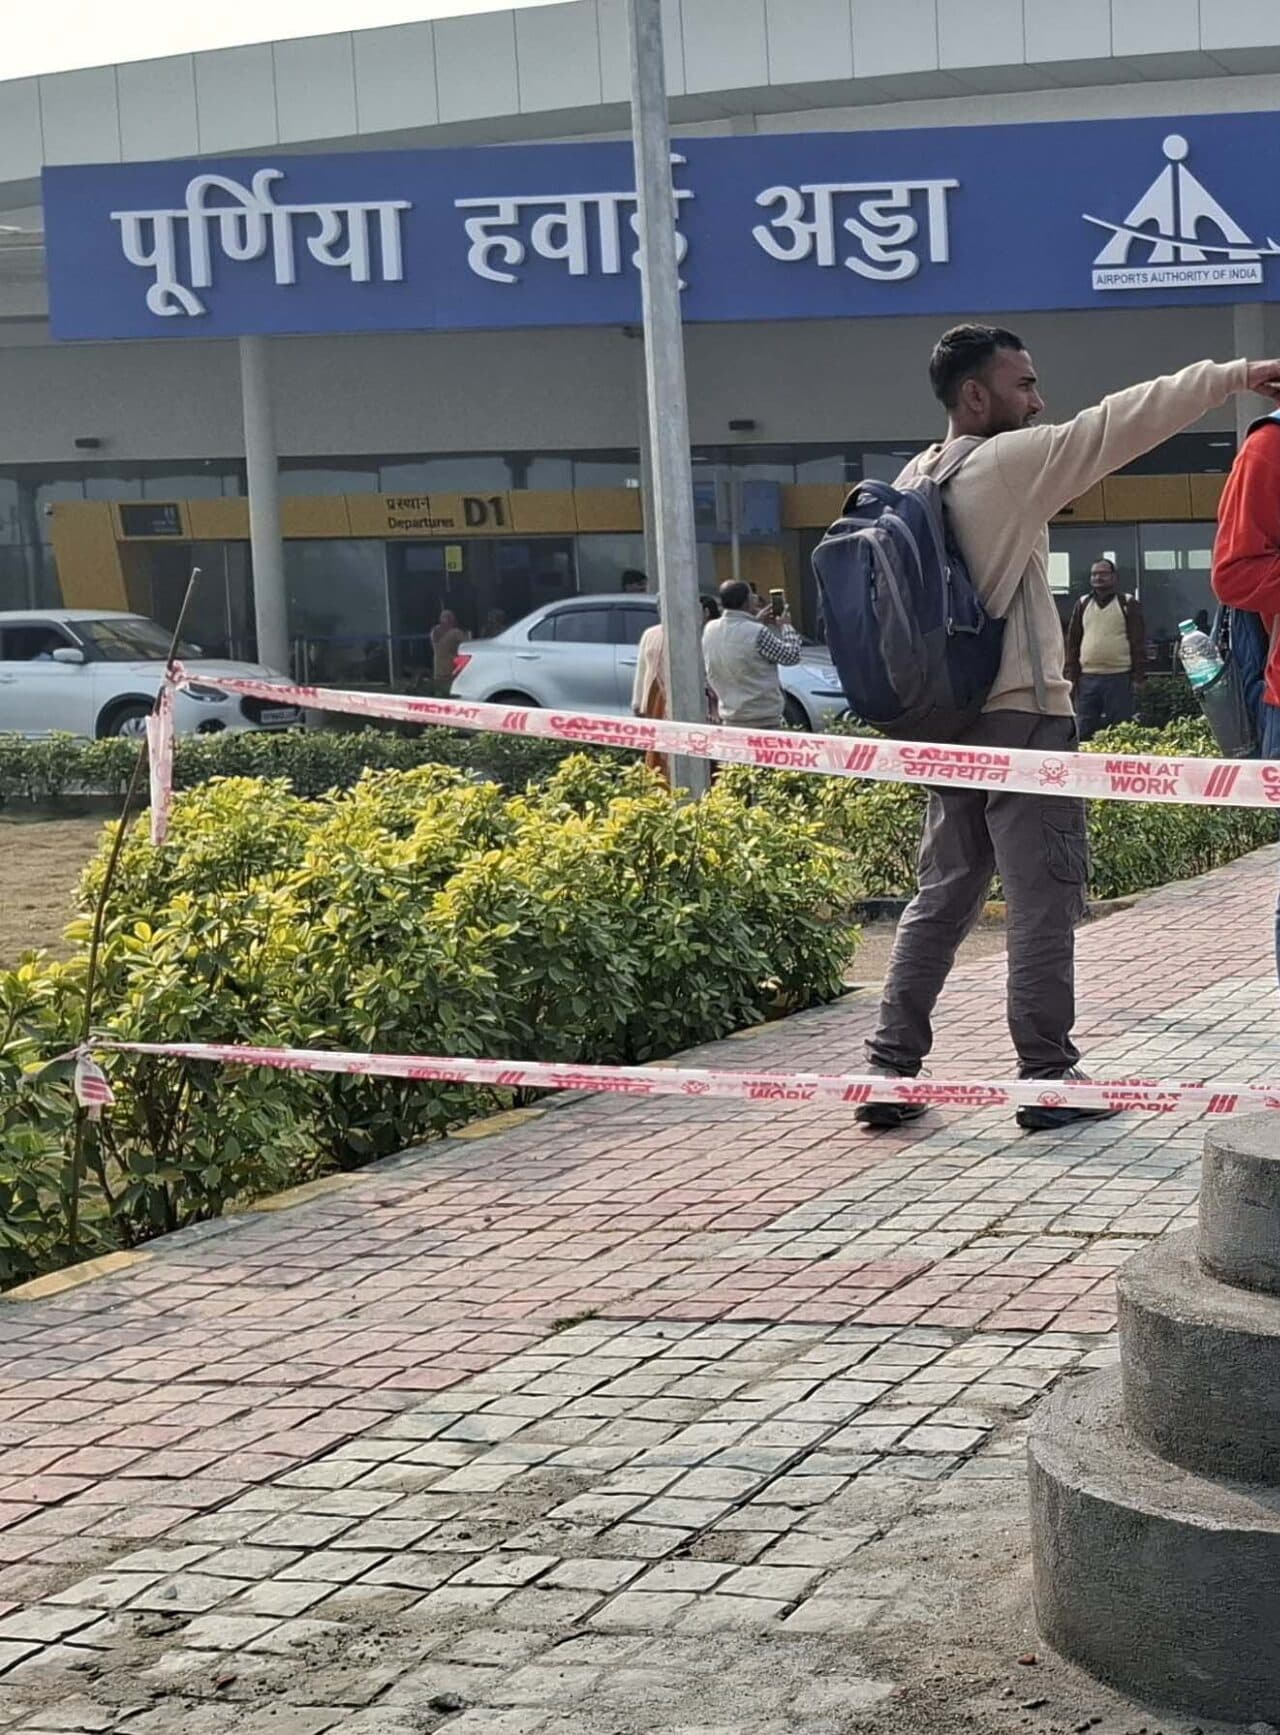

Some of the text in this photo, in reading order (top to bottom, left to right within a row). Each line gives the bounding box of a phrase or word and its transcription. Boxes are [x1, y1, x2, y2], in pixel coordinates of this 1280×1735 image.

[110, 168, 412, 316] पूर्णिया
[752, 178, 960, 281] अड्डा
[1096, 268, 1257, 285] AIRPORTS AUTHORITY OF INDIA
[463, 496, 505, 527] D1
[388, 517, 455, 531] Departures
[550, 716, 657, 738] CAUTION
[747, 736, 825, 750] MEN AT
[755, 749, 820, 767] WORK
[900, 746, 1010, 767] CAUTION
[903, 760, 1012, 784] सावधान
[1105, 760, 1184, 777] MEN AT
[1111, 775, 1178, 796] WORK
